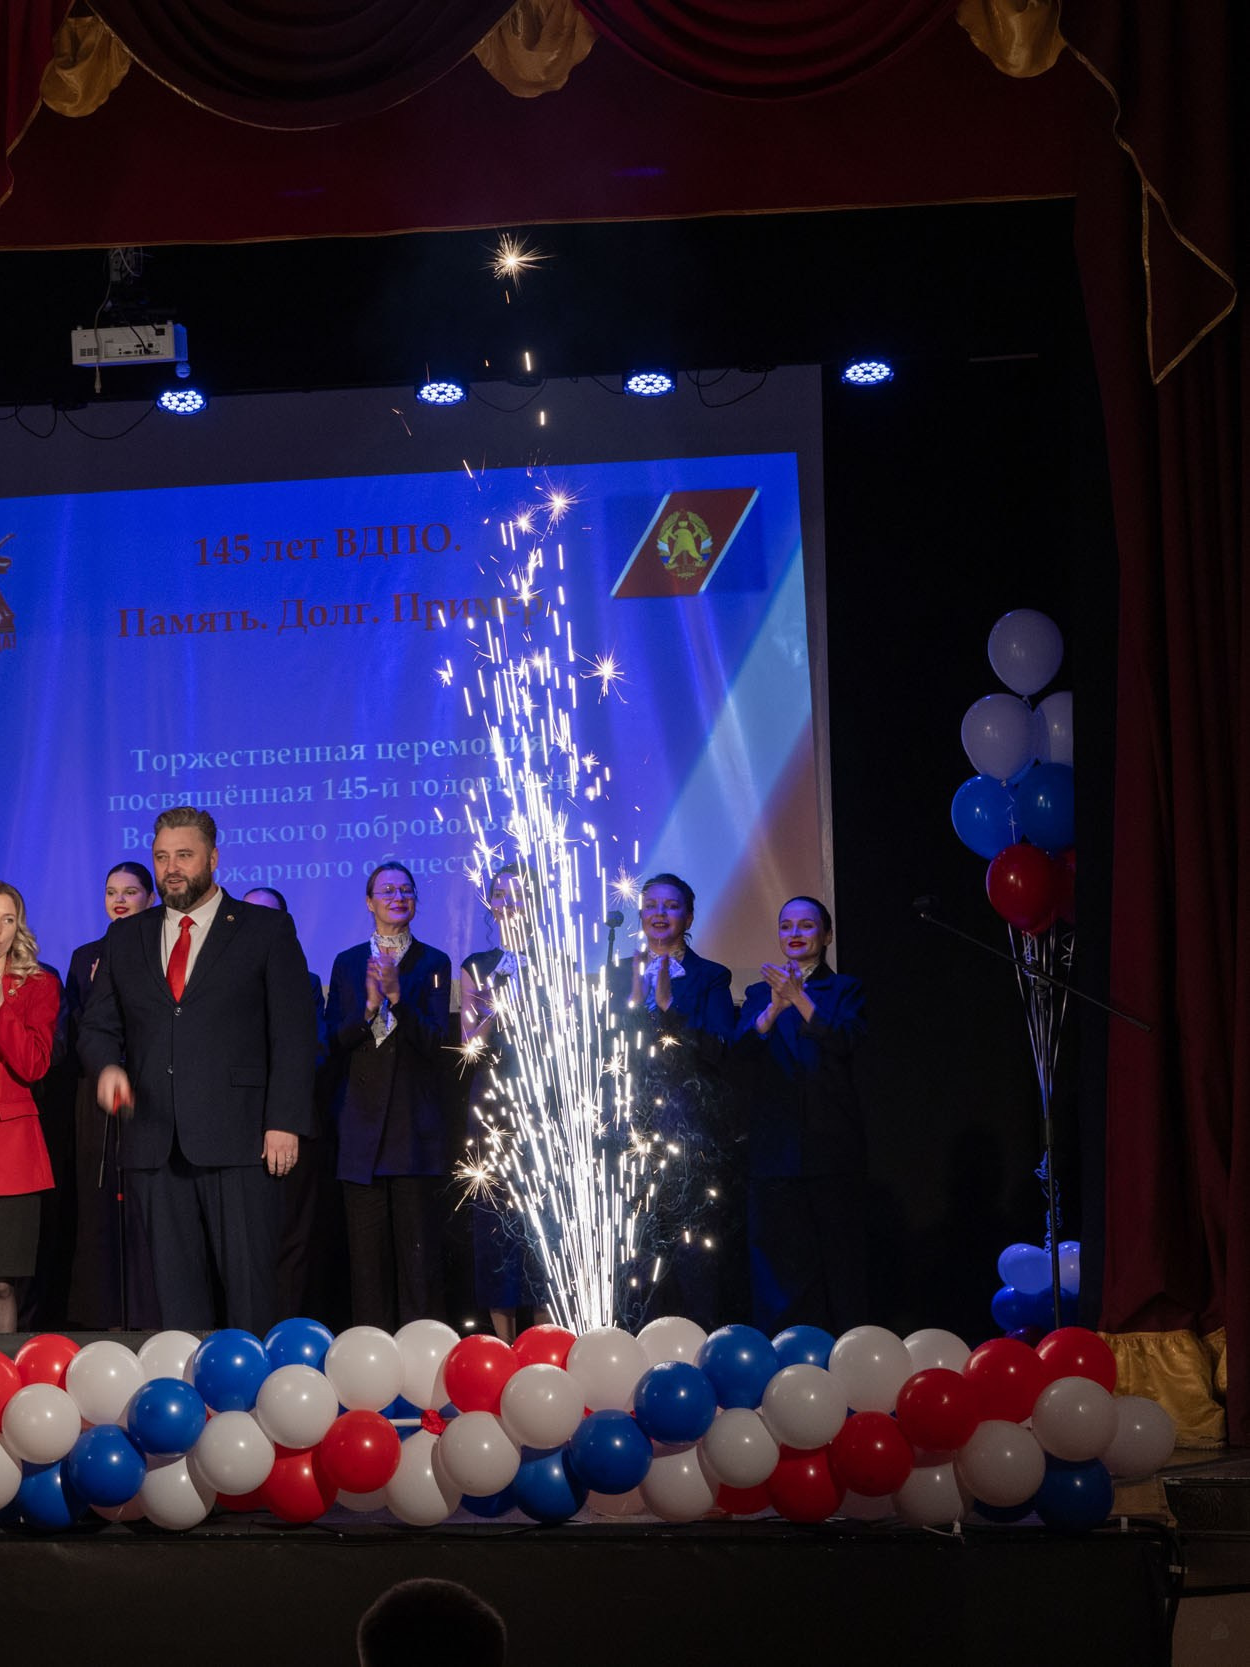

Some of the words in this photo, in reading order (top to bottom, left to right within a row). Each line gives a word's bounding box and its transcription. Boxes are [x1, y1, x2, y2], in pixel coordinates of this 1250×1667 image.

[194, 534, 250, 566] 145
[261, 538, 324, 563] лет
[335, 523, 461, 564] ВДПО.
[118, 608, 268, 637] Память.
[277, 599, 379, 635] Долг.
[130, 744, 366, 777] Торжественная
[108, 784, 313, 812] посвящённая
[322, 776, 398, 801] 145-й
[122, 823, 327, 850] Воодского
